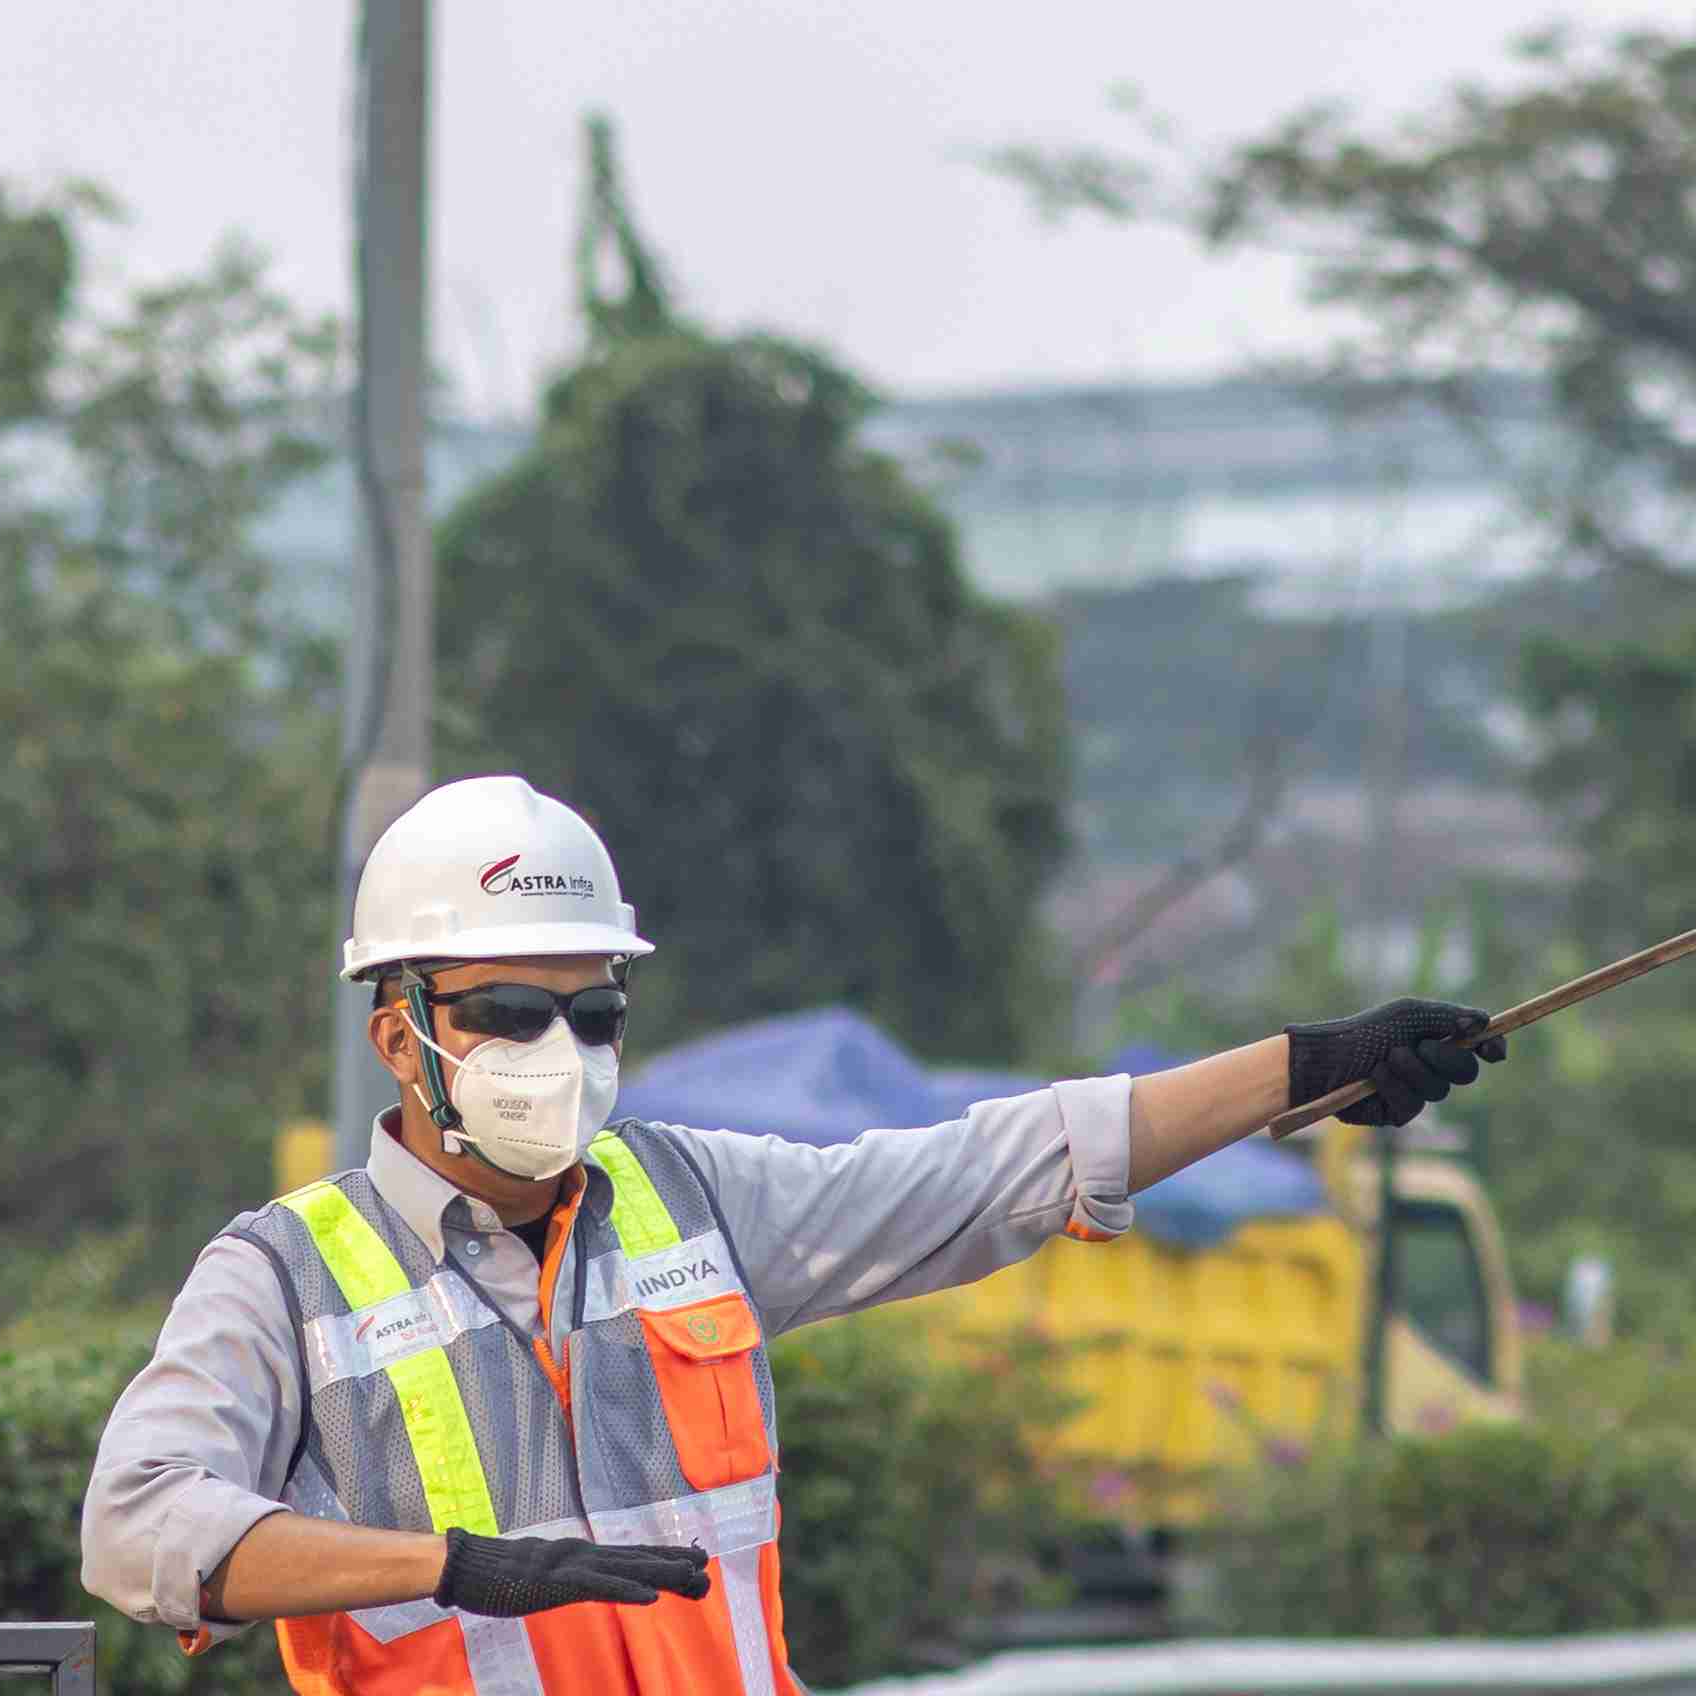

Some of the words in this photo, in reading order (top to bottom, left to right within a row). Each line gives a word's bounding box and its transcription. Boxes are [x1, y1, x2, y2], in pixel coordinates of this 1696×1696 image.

[510, 875, 566, 891] ASTRA
[635, 1259, 719, 1297] IINDYA
[375, 1317, 413, 1340] ASTRA
